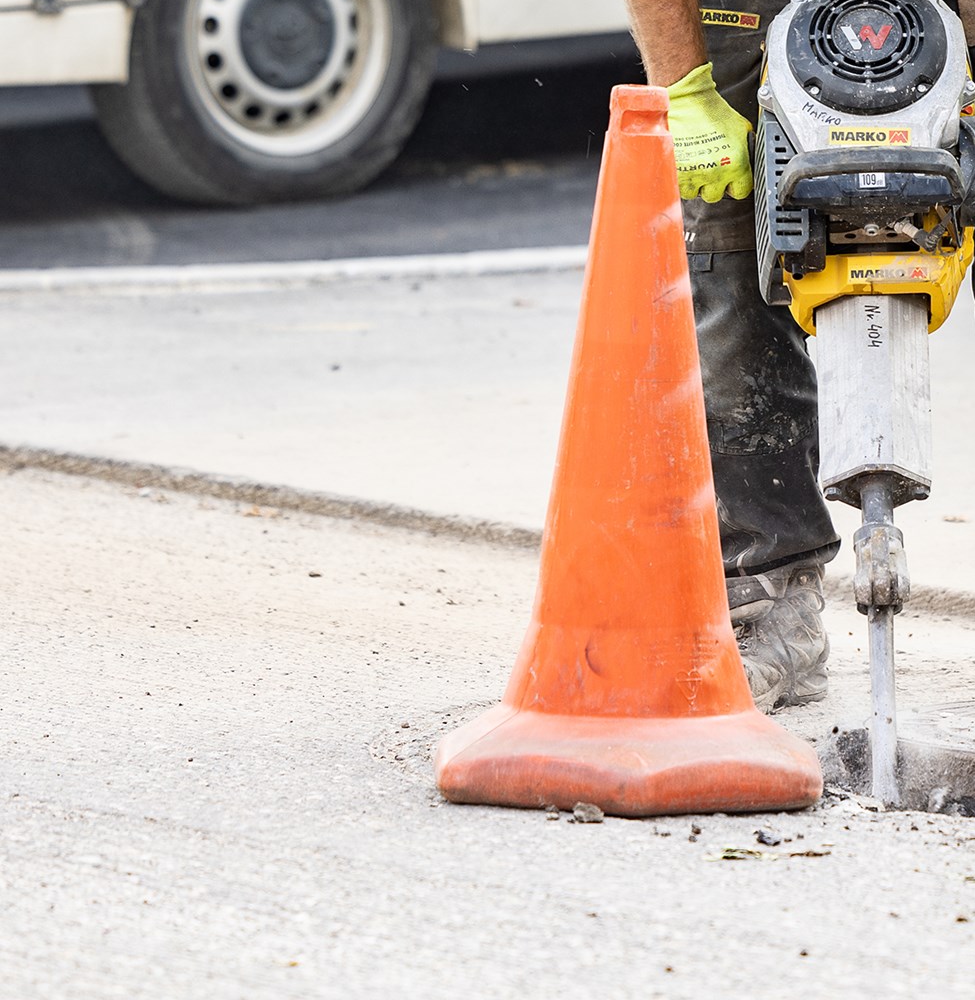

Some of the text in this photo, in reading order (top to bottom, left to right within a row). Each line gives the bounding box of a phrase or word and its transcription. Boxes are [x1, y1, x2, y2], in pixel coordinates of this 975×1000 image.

[702, 11, 740, 24] ARKO
[831, 131, 887, 142] MARKO
[862, 173, 876, 186] 109
[850, 269, 905, 279] MARKO
[867, 324, 883, 348] 404
